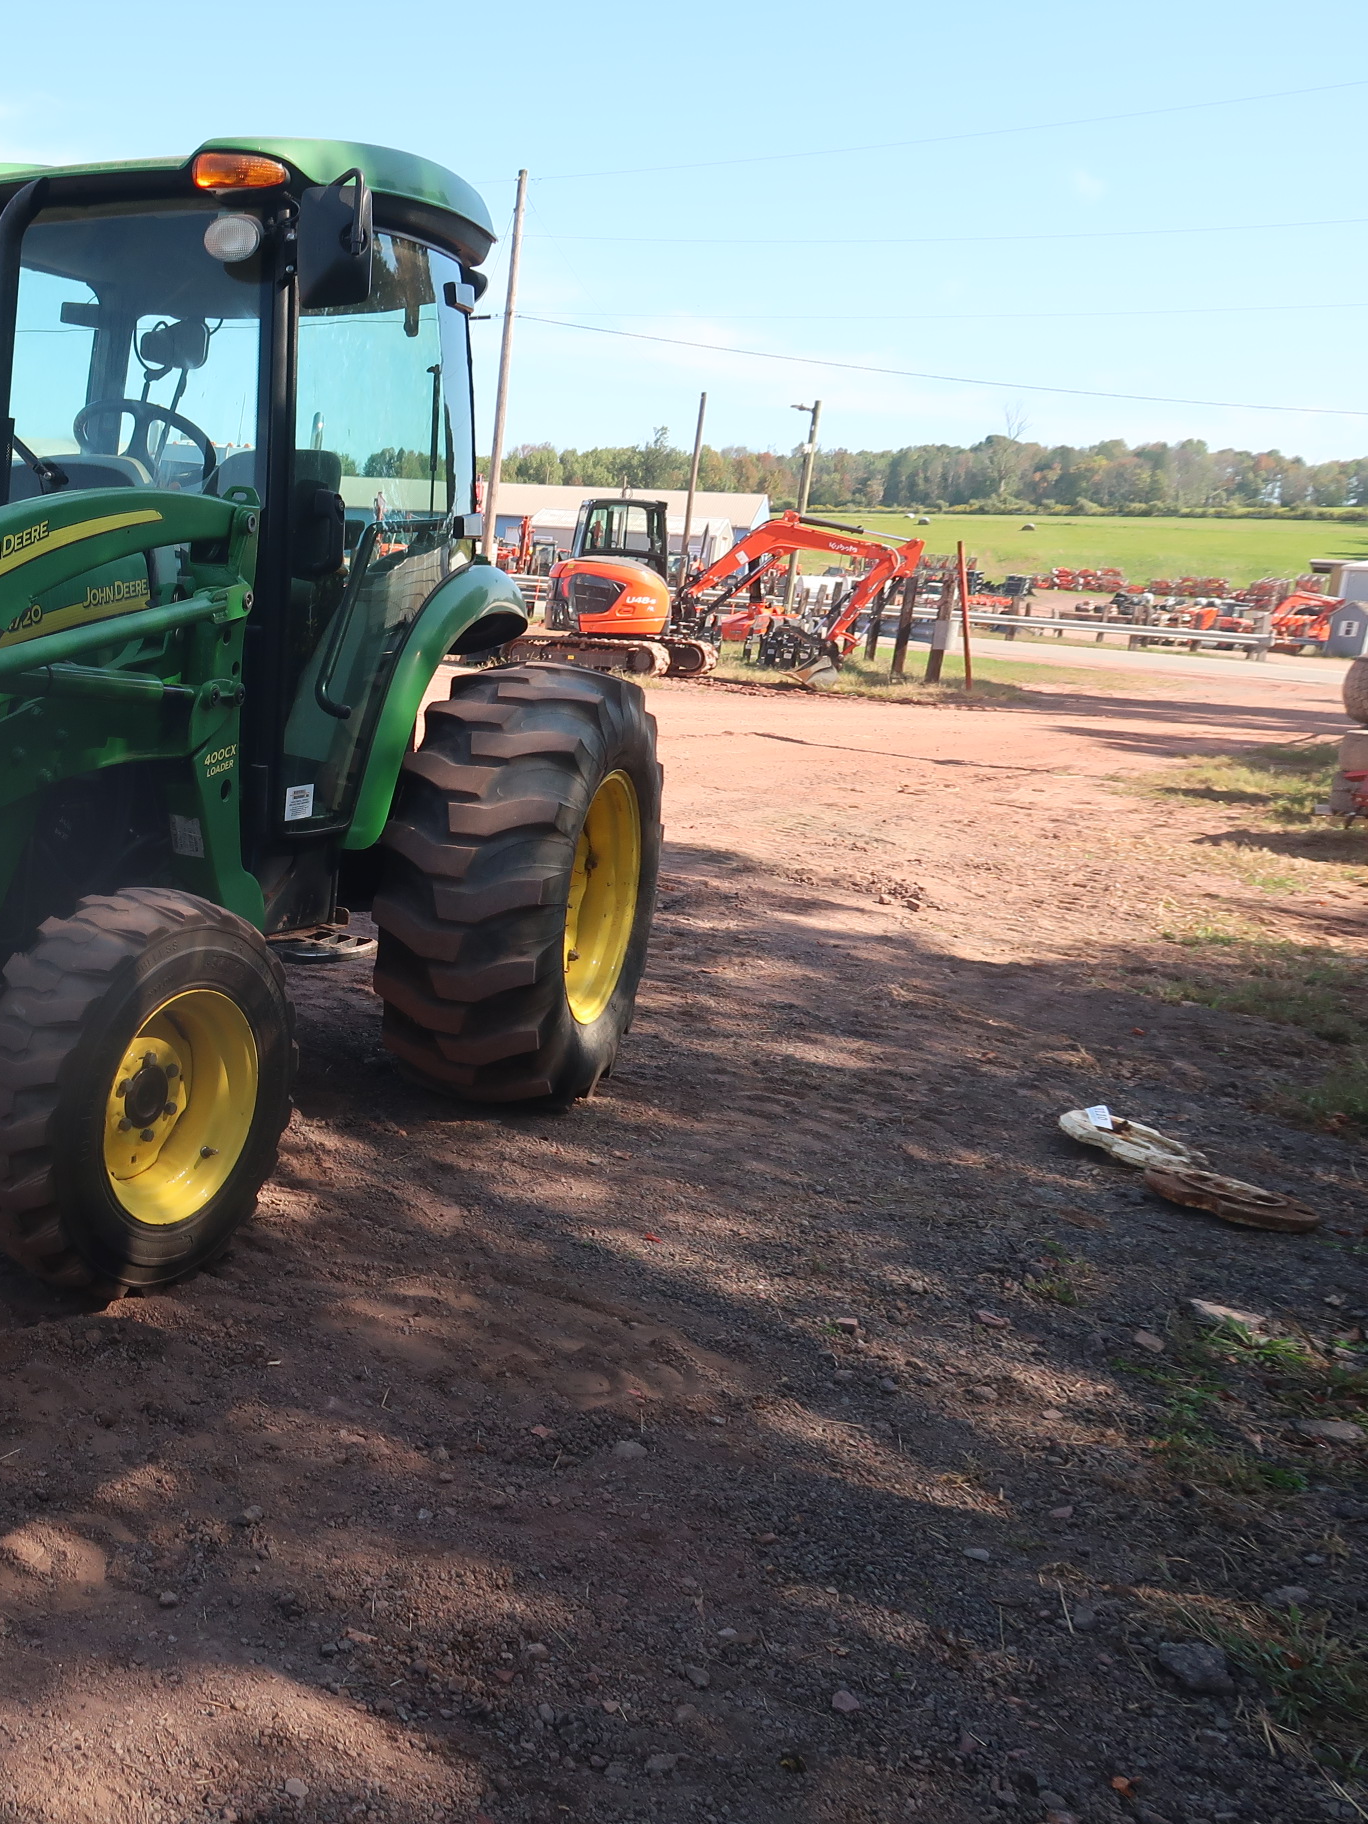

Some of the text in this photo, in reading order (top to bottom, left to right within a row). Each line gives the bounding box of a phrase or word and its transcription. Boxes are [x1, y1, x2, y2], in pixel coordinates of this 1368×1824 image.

[2, 520, 50, 558] DEERE
[83, 578, 148, 608] JOHN DEERE
[204, 743, 237, 766] 400CX
[206, 759, 234, 778] LOADER
